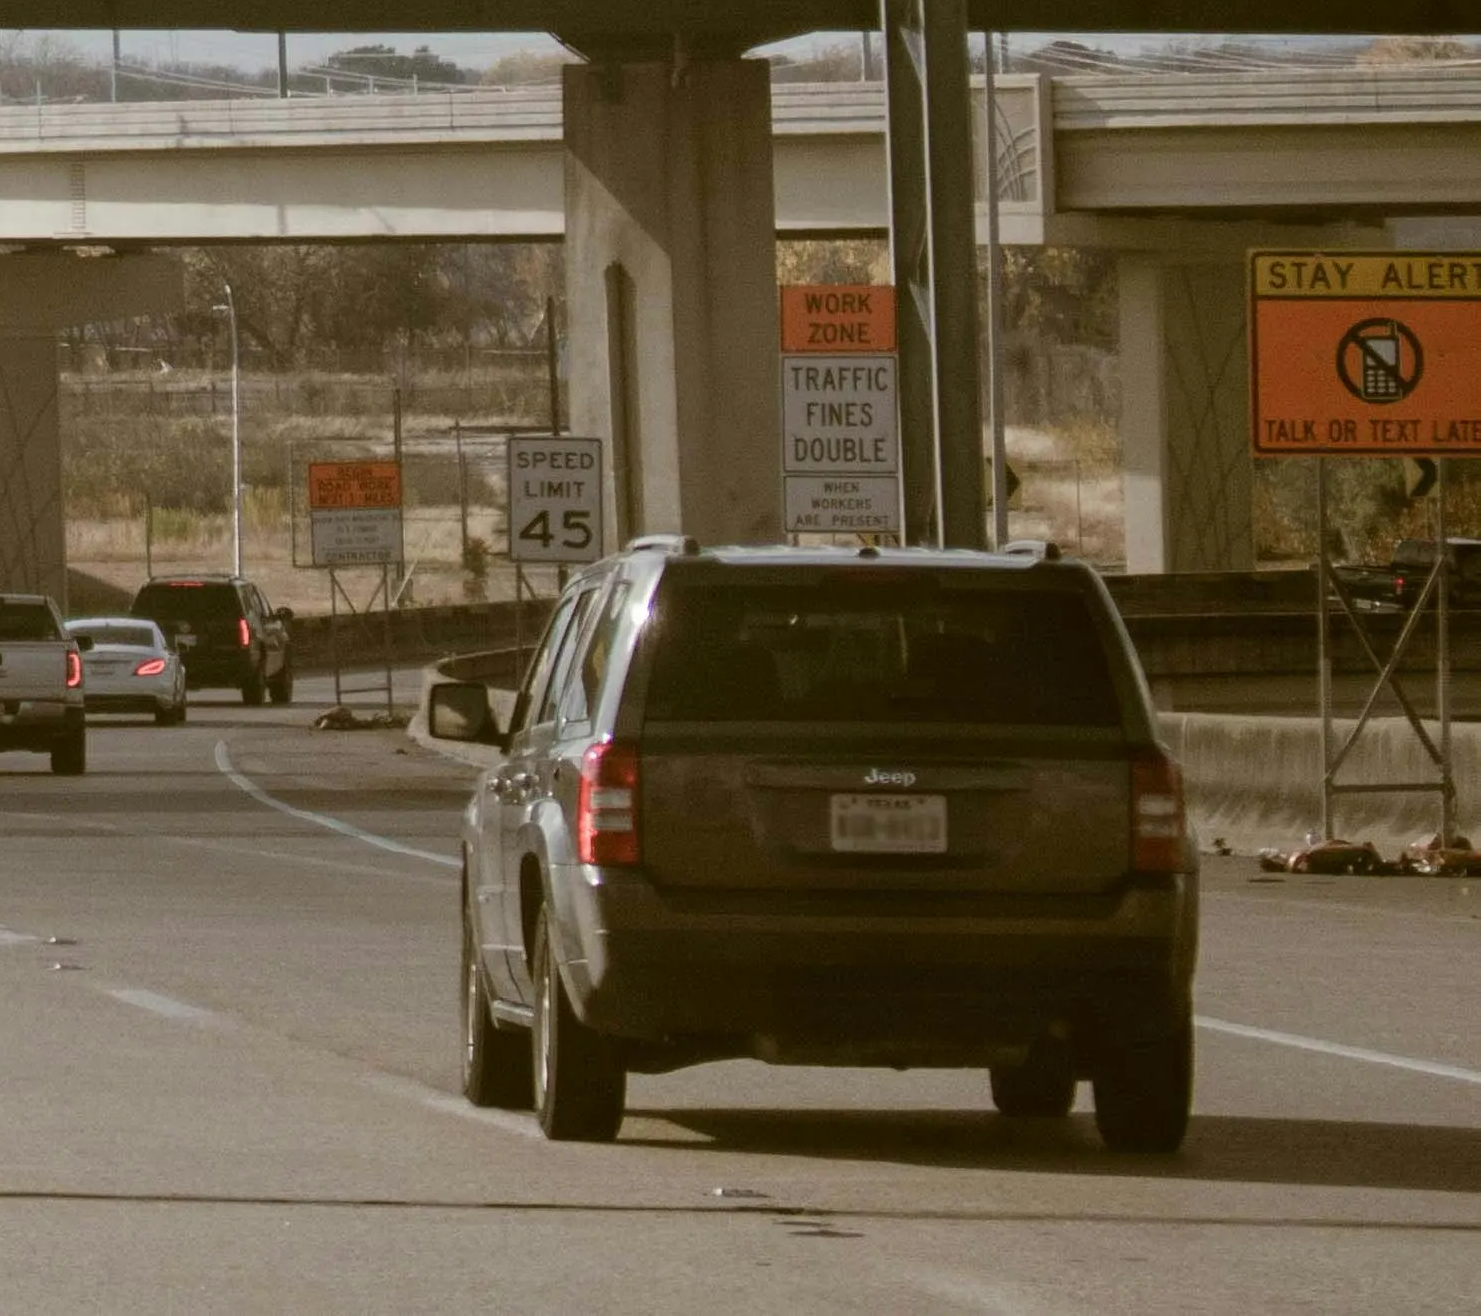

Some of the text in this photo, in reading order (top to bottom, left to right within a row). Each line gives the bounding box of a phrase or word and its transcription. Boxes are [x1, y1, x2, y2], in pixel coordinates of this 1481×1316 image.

[1269, 261, 1355, 290] STAY
[805, 293, 873, 315] WORK
[807, 322, 872, 344] ZONE
[791, 367, 889, 392] TRAFFIC
[806, 403, 874, 427] FINES
[1264, 419, 1317, 443] TALK
[1327, 419, 1358, 443] OR
[1369, 419, 1423, 442] TEXT
[515, 451, 595, 471] SPEED
[793, 437, 888, 463] DOUBLE
[524, 481, 586, 499] LIMIT
[823, 482, 860, 494] WHEN
[811, 498, 872, 510] WORKERS
[518, 510, 594, 550] 45
[796, 514, 890, 527] ARE PRESENT
[863, 768, 917, 787] Jeep
